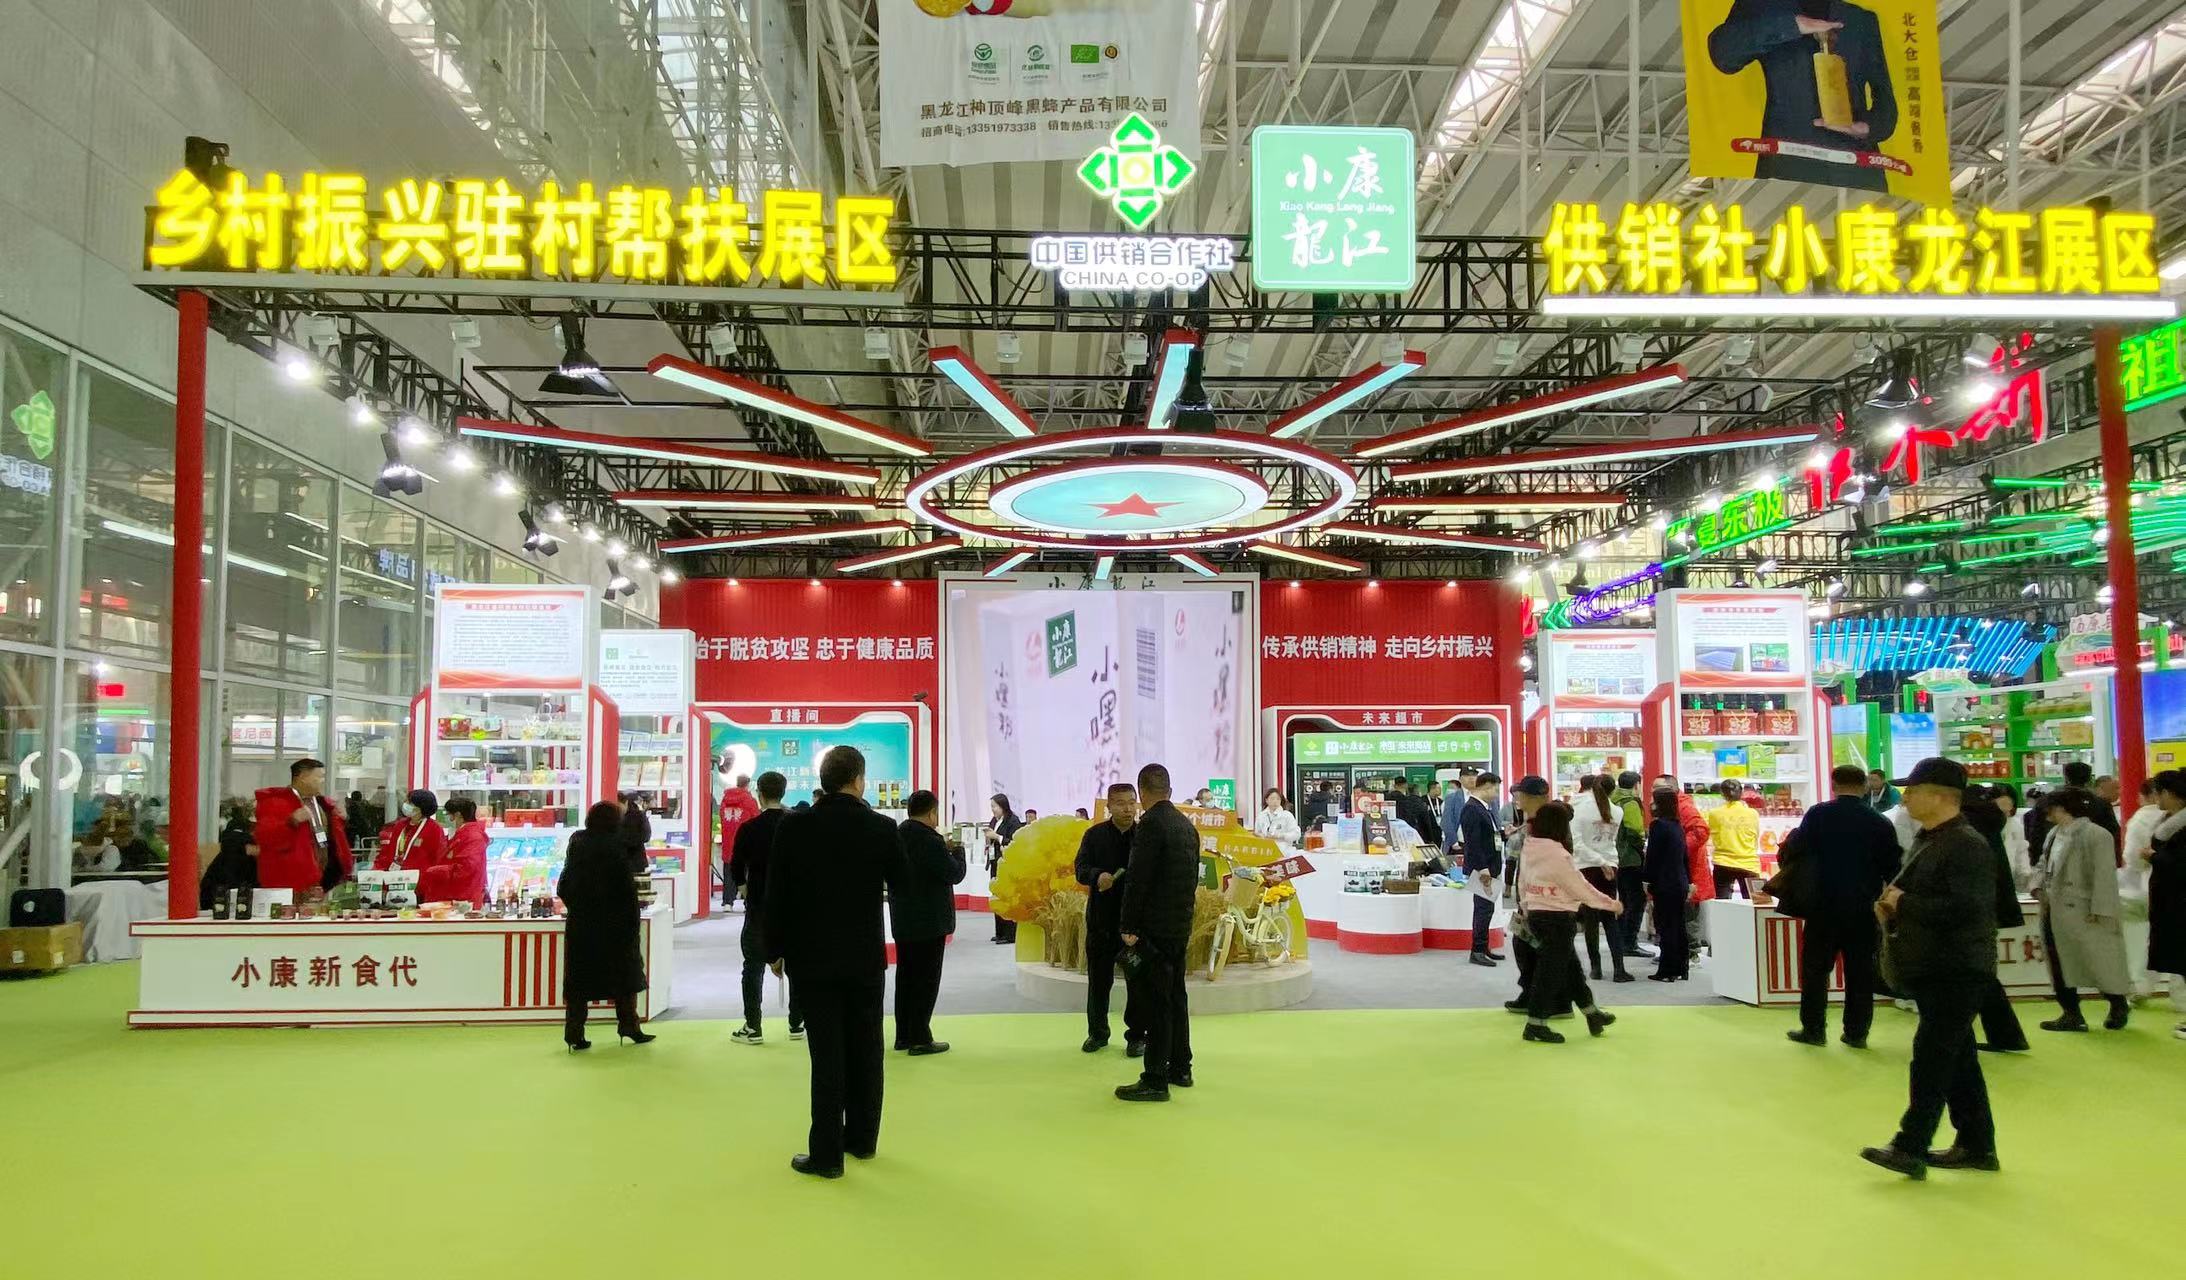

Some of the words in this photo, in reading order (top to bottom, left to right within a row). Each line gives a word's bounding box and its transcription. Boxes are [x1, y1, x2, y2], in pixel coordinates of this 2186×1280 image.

[920, 95, 1168, 119] 黑龙江神顶峰黑蜂产品有限公司
[1284, 144, 1385, 200] 小康
[149, 168, 898, 286] 乡村振兴驻村帮扶展区
[1035, 240, 1231, 267] 中国供销合作社
[1543, 203, 2161, 296] 供销社小康龙江展区
[1064, 271, 1128, 285] CHINA
[1136, 271, 1204, 285] CO-OP
[696, 636, 810, 661] 始于脱贫攻坚
[816, 636, 934, 661] 忠于健康品质
[1262, 635, 1377, 659] 传承供销精神
[1384, 635, 1494, 659] 走向乡村振兴
[769, 709, 820, 723] 直播间
[1362, 711, 1424, 725] 未来超市
[1224, 844, 1274, 856] HARBIN
[231, 954, 418, 988] 小康新食代
